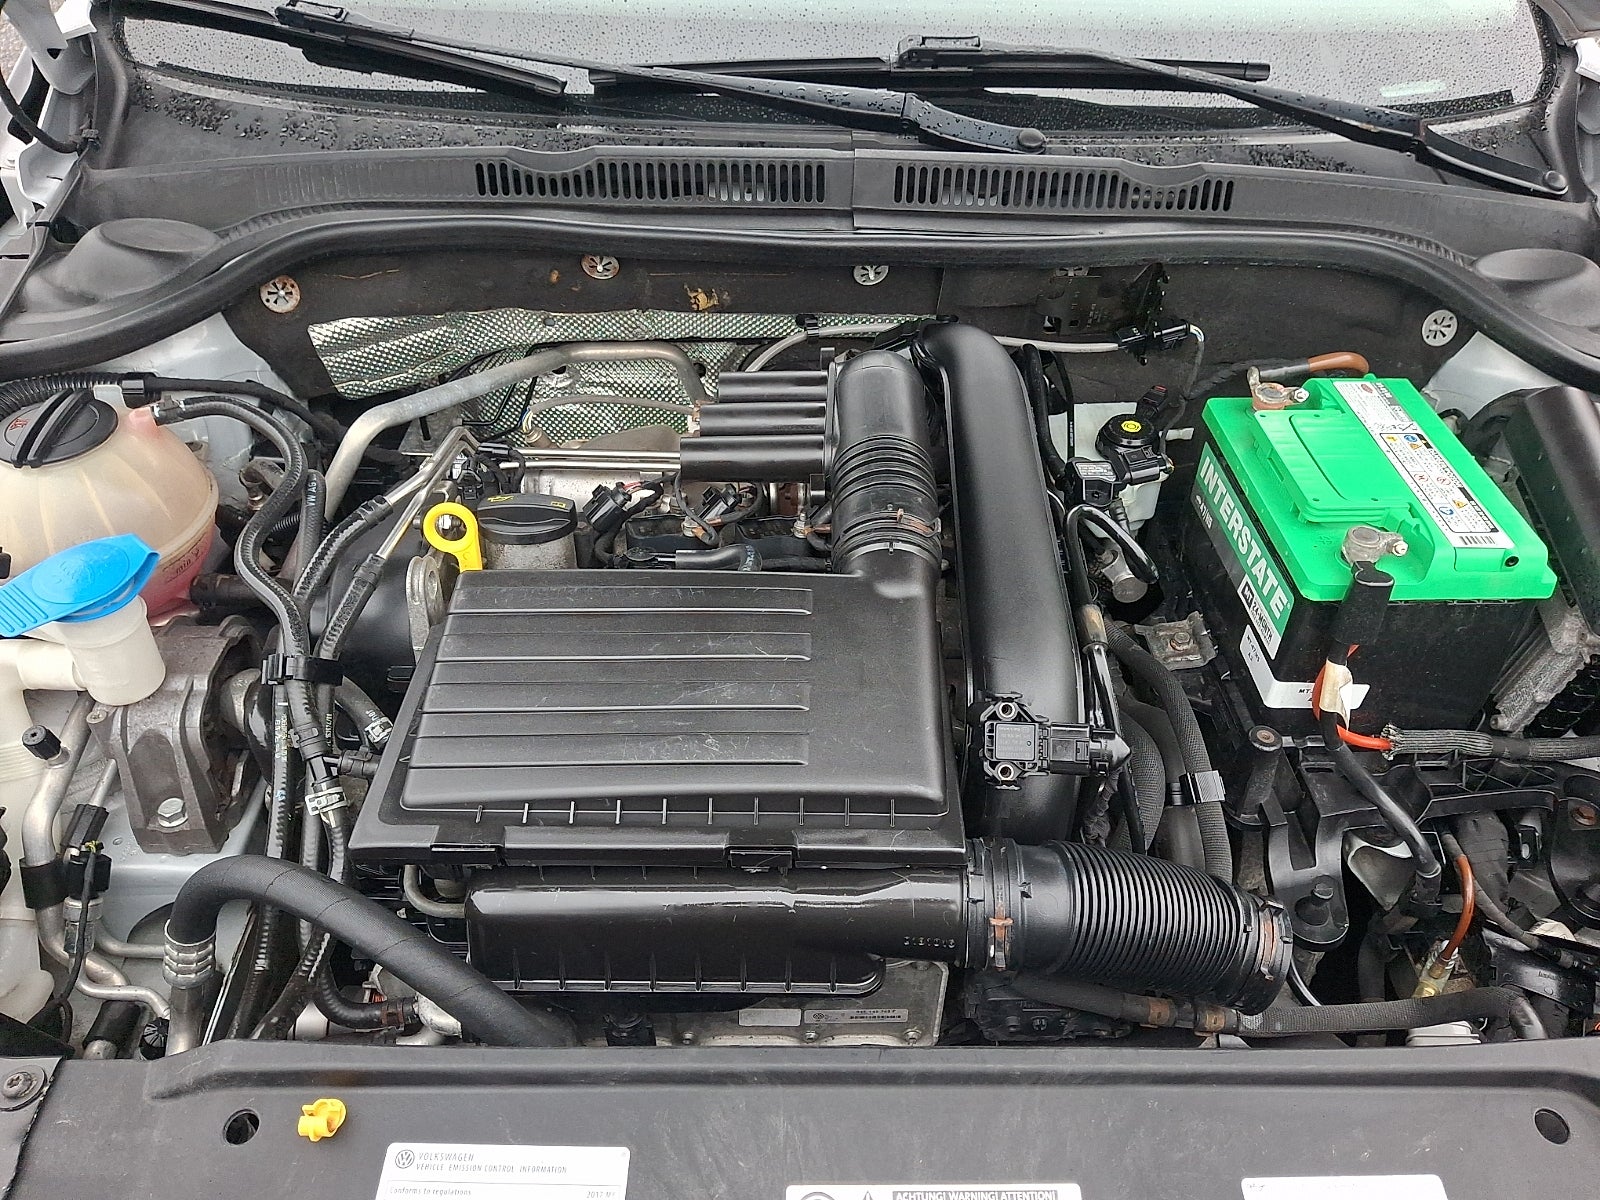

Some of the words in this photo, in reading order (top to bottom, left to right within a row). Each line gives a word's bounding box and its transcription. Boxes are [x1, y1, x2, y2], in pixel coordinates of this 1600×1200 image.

[308, 482, 317, 493] AG
[307, 495, 316, 506] VW
[1200, 456, 1289, 620] INTERSTATE
[418, 1152, 475, 1162] VOLKSWAGEN
[416, 1163, 445, 1171] VEHICLE
[448, 1164, 482, 1172] EMISSION
[484, 1164, 515, 1173] CONTROL
[519, 1165, 568, 1174] INFORMATION
[390, 1186, 421, 1195] Conforms
[423, 1187, 431, 1195] to
[432, 1187, 472, 1197] regulations
[586, 1191, 604, 1199] 2017
[896, 1191, 946, 1200] ACHTUNG!
[948, 1191, 998, 1200] WARNING!
[1000, 1191, 1056, 1200] ATTENTION!
